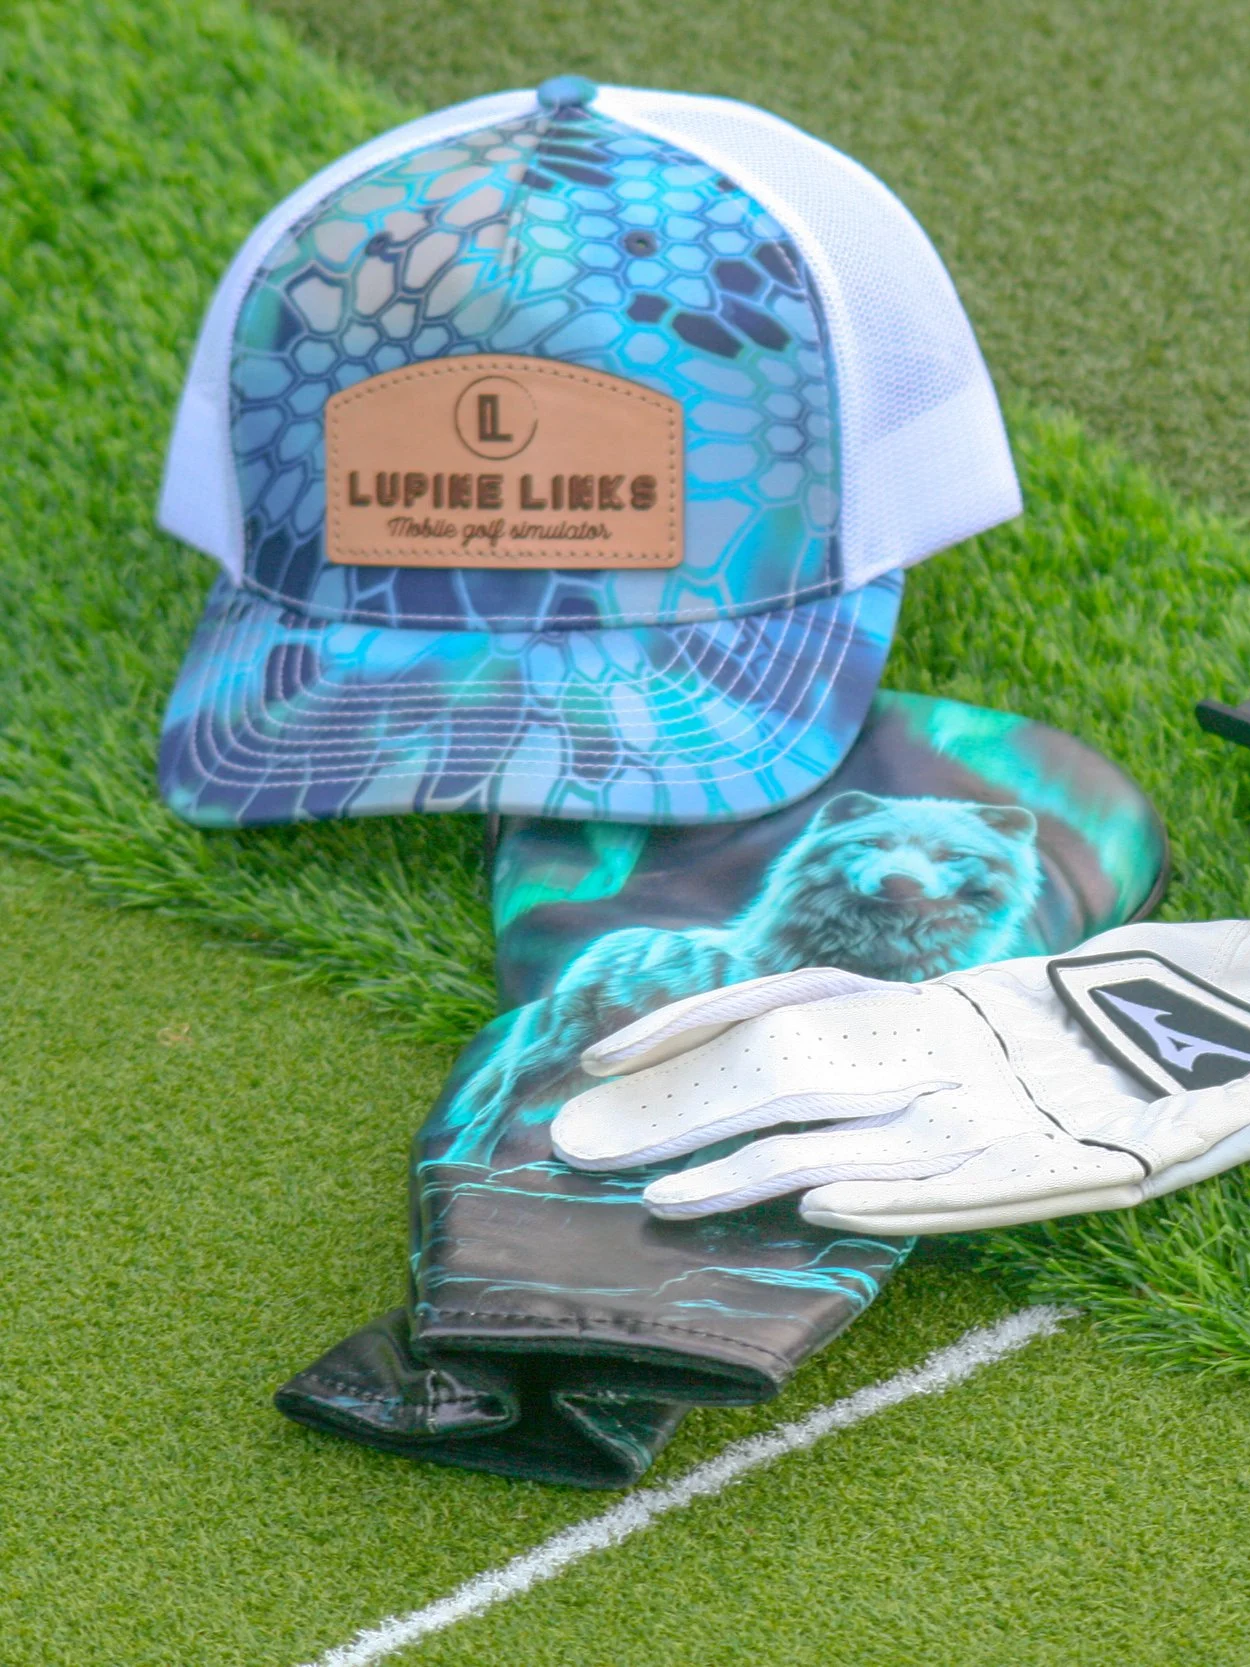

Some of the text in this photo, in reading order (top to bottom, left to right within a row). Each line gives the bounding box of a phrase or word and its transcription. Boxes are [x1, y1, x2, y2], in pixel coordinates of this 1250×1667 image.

[348, 470, 658, 511] LUPINE LINKS
[387, 515, 612, 547] Mobile golf simulator
